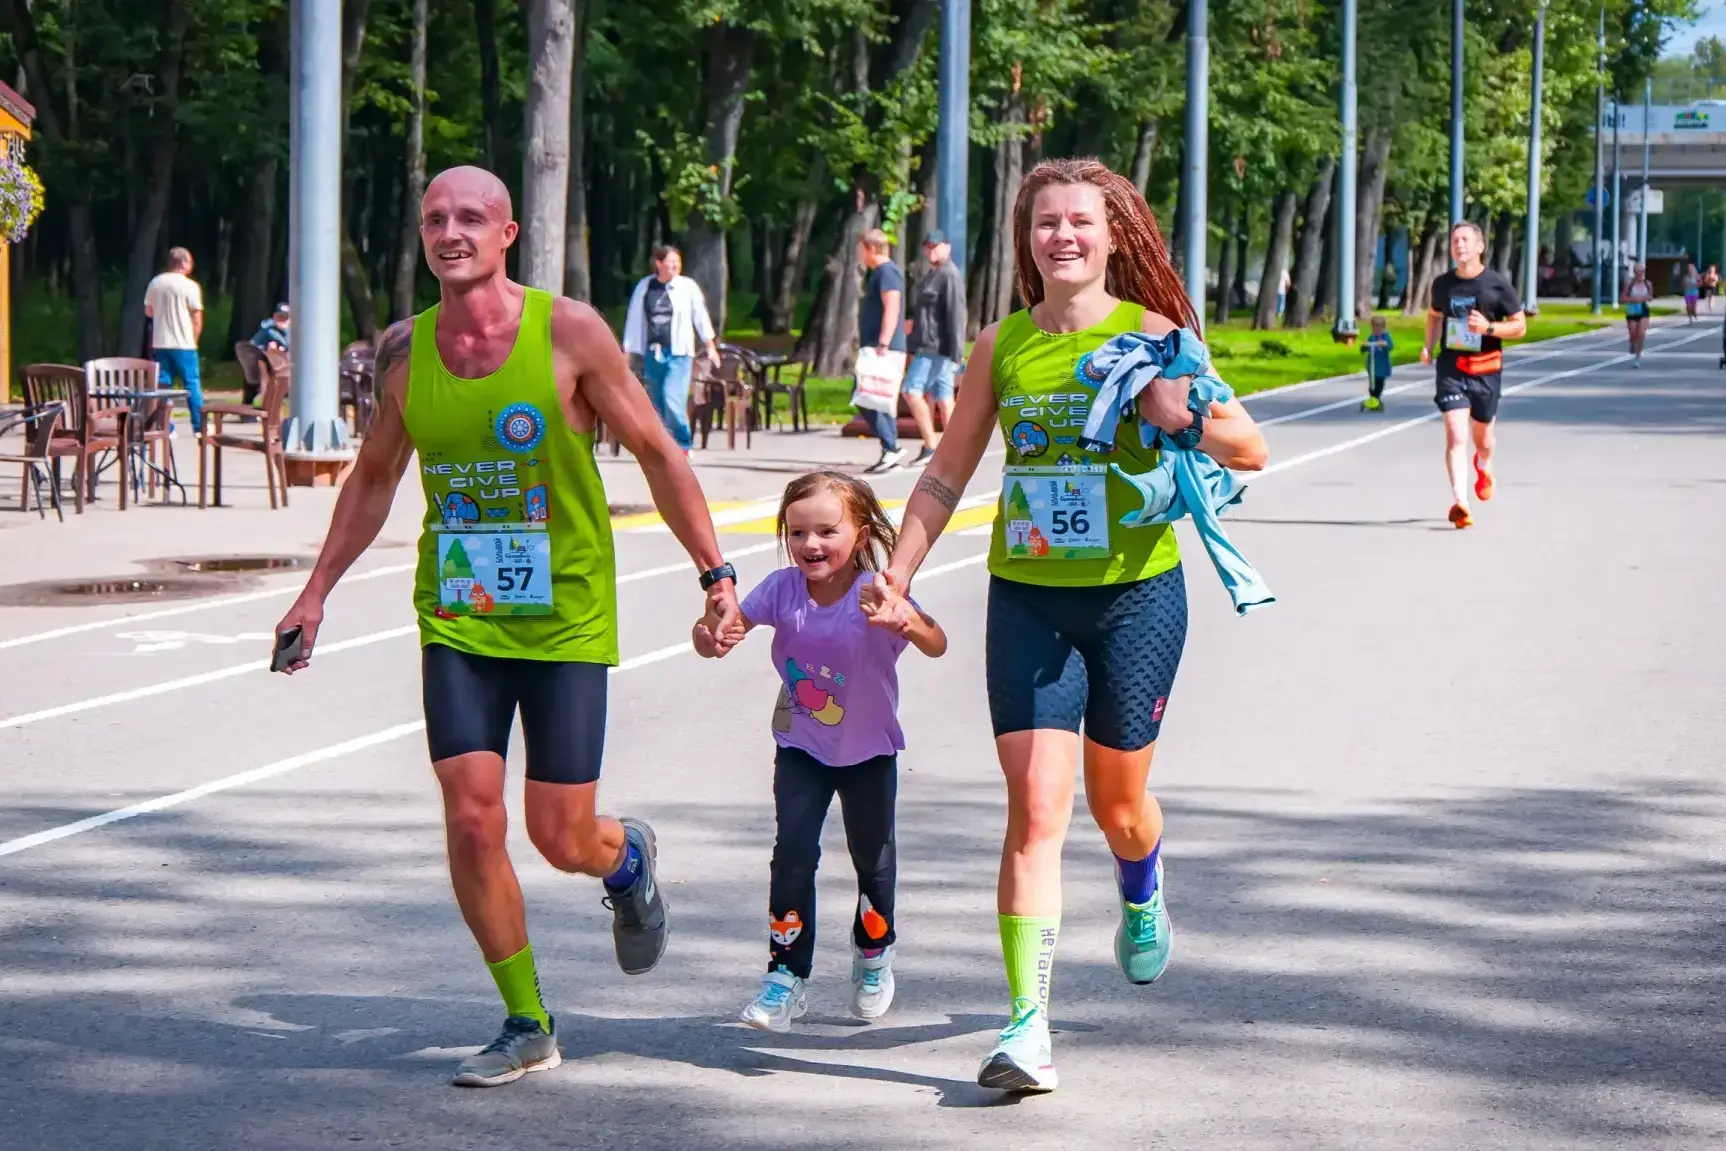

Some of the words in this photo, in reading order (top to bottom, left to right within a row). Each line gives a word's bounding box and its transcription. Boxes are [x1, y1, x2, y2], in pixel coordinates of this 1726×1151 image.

[1000, 393, 1089, 408] NEVER
[1019, 406, 1088, 418] GIVE
[1048, 418, 1088, 428] UP
[424, 460, 516, 475] NEVER
[449, 474, 517, 488] GIVE
[480, 487, 521, 499] UP
[1051, 509, 1090, 535] 56
[497, 566, 534, 592] 57
